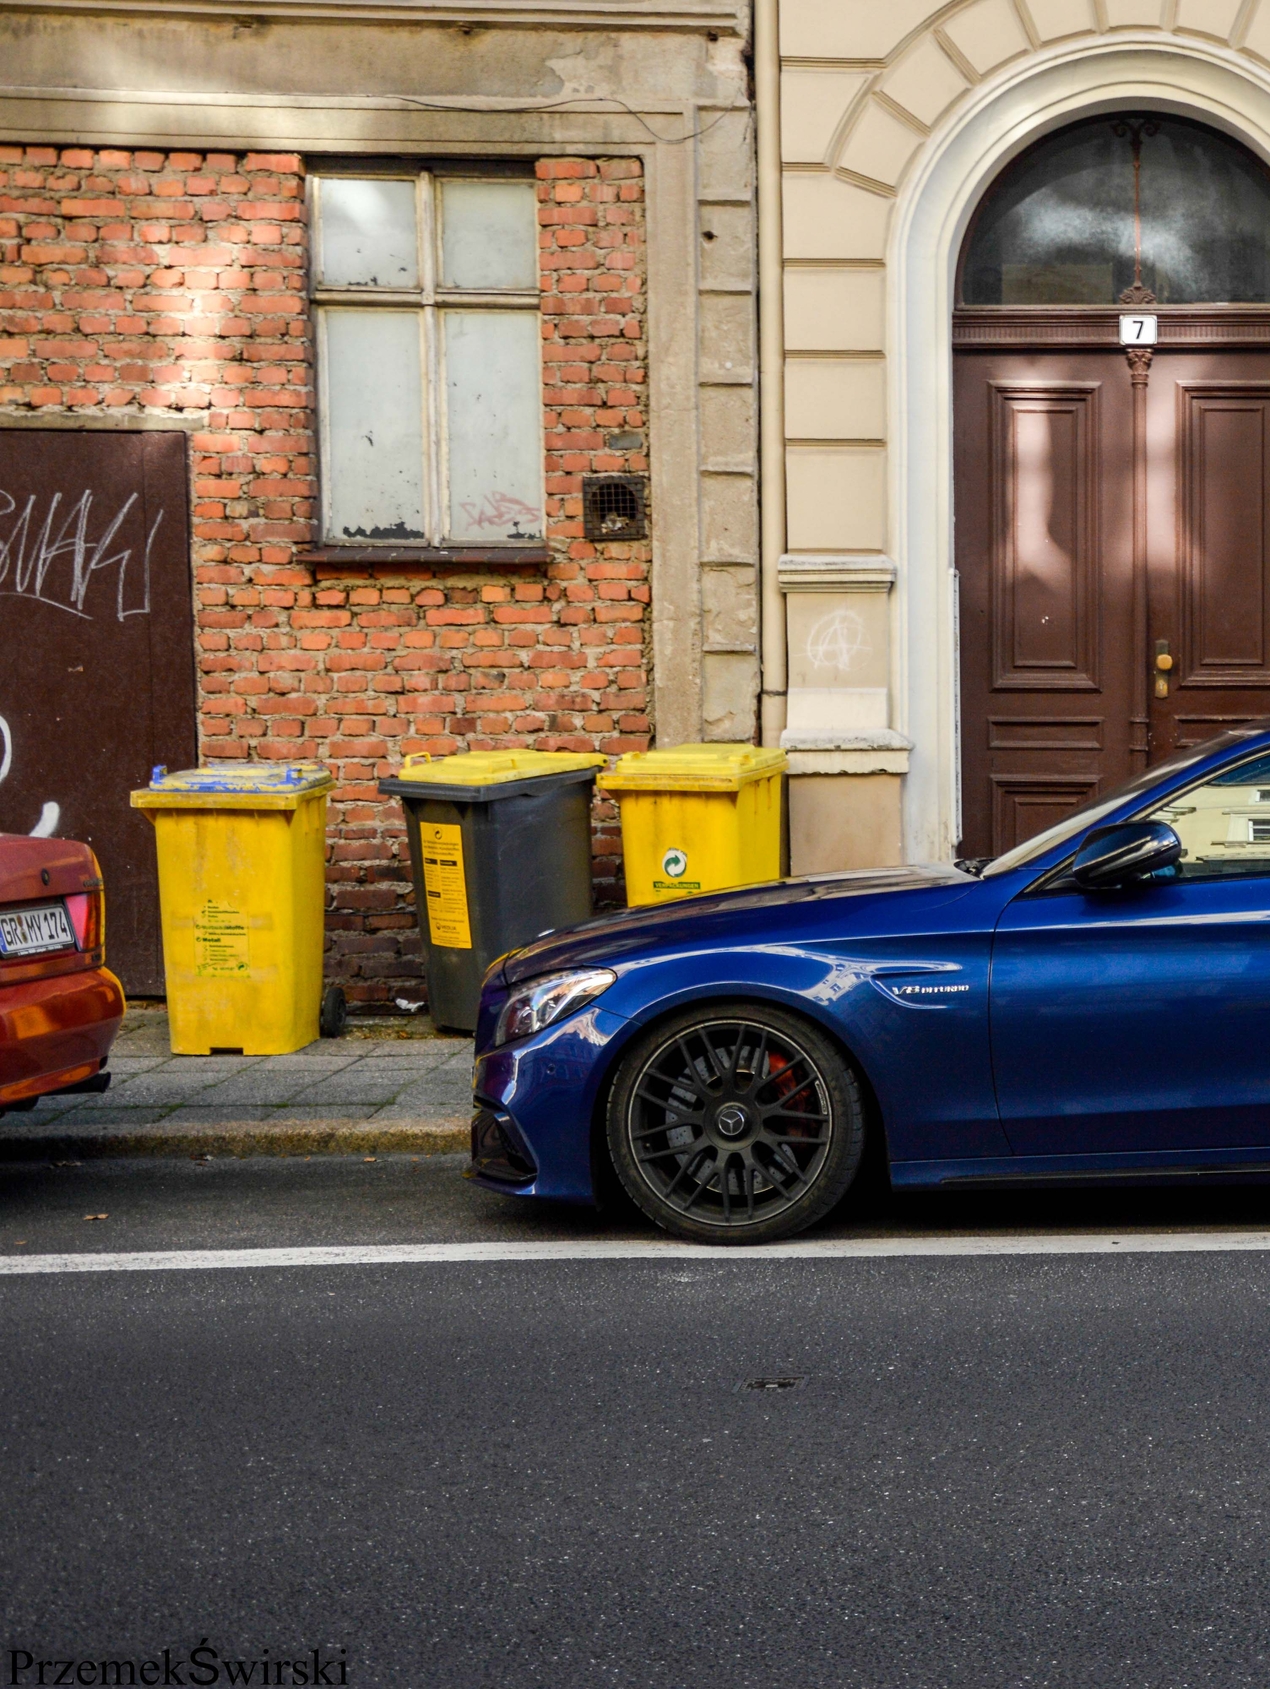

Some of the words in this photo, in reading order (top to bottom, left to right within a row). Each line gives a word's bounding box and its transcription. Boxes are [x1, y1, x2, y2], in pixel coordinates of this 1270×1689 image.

[1132, 320, 1145, 340] 7
[0, 917, 22, 946] GR
[25, 914, 44, 942] MY
[44, 911, 68, 940] 174
[892, 985, 920, 995] V8
